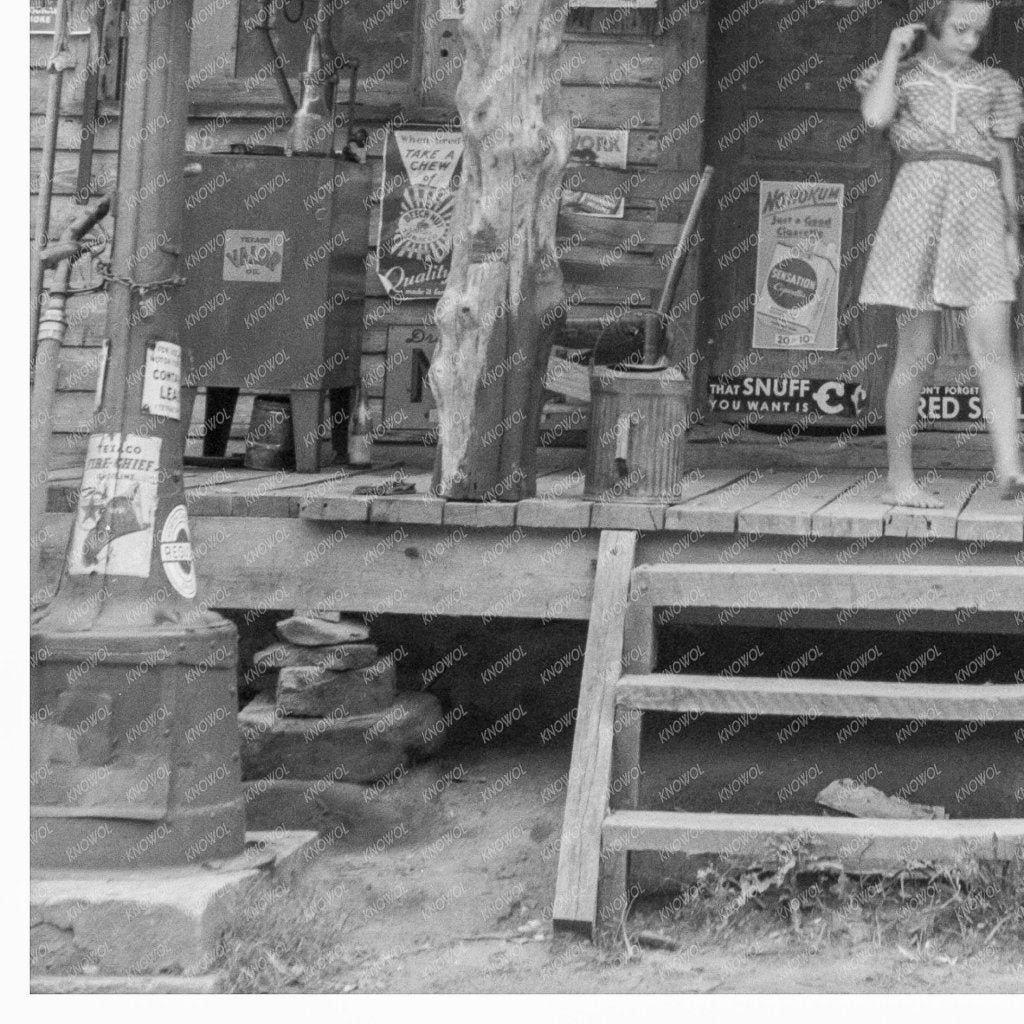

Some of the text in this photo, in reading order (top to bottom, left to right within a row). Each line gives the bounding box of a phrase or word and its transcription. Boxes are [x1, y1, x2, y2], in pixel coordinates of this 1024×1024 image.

[401, 135, 429, 144] when
[405, 149, 455, 160] TAKE A
[409, 160, 452, 172] CHEW
[422, 173, 438, 186] of
[762, 186, 841, 215] NO HOKUM
[771, 215, 792, 225] Just
[804, 215, 832, 226] Good
[385, 263, 450, 293] Quality
[771, 268, 816, 290] SENSATION
[709, 377, 811, 398] THAT SNUFF
[944, 386, 980, 396] FORGET
[709, 399, 809, 413] YOU WANT IS
[917, 396, 960, 420] RED
